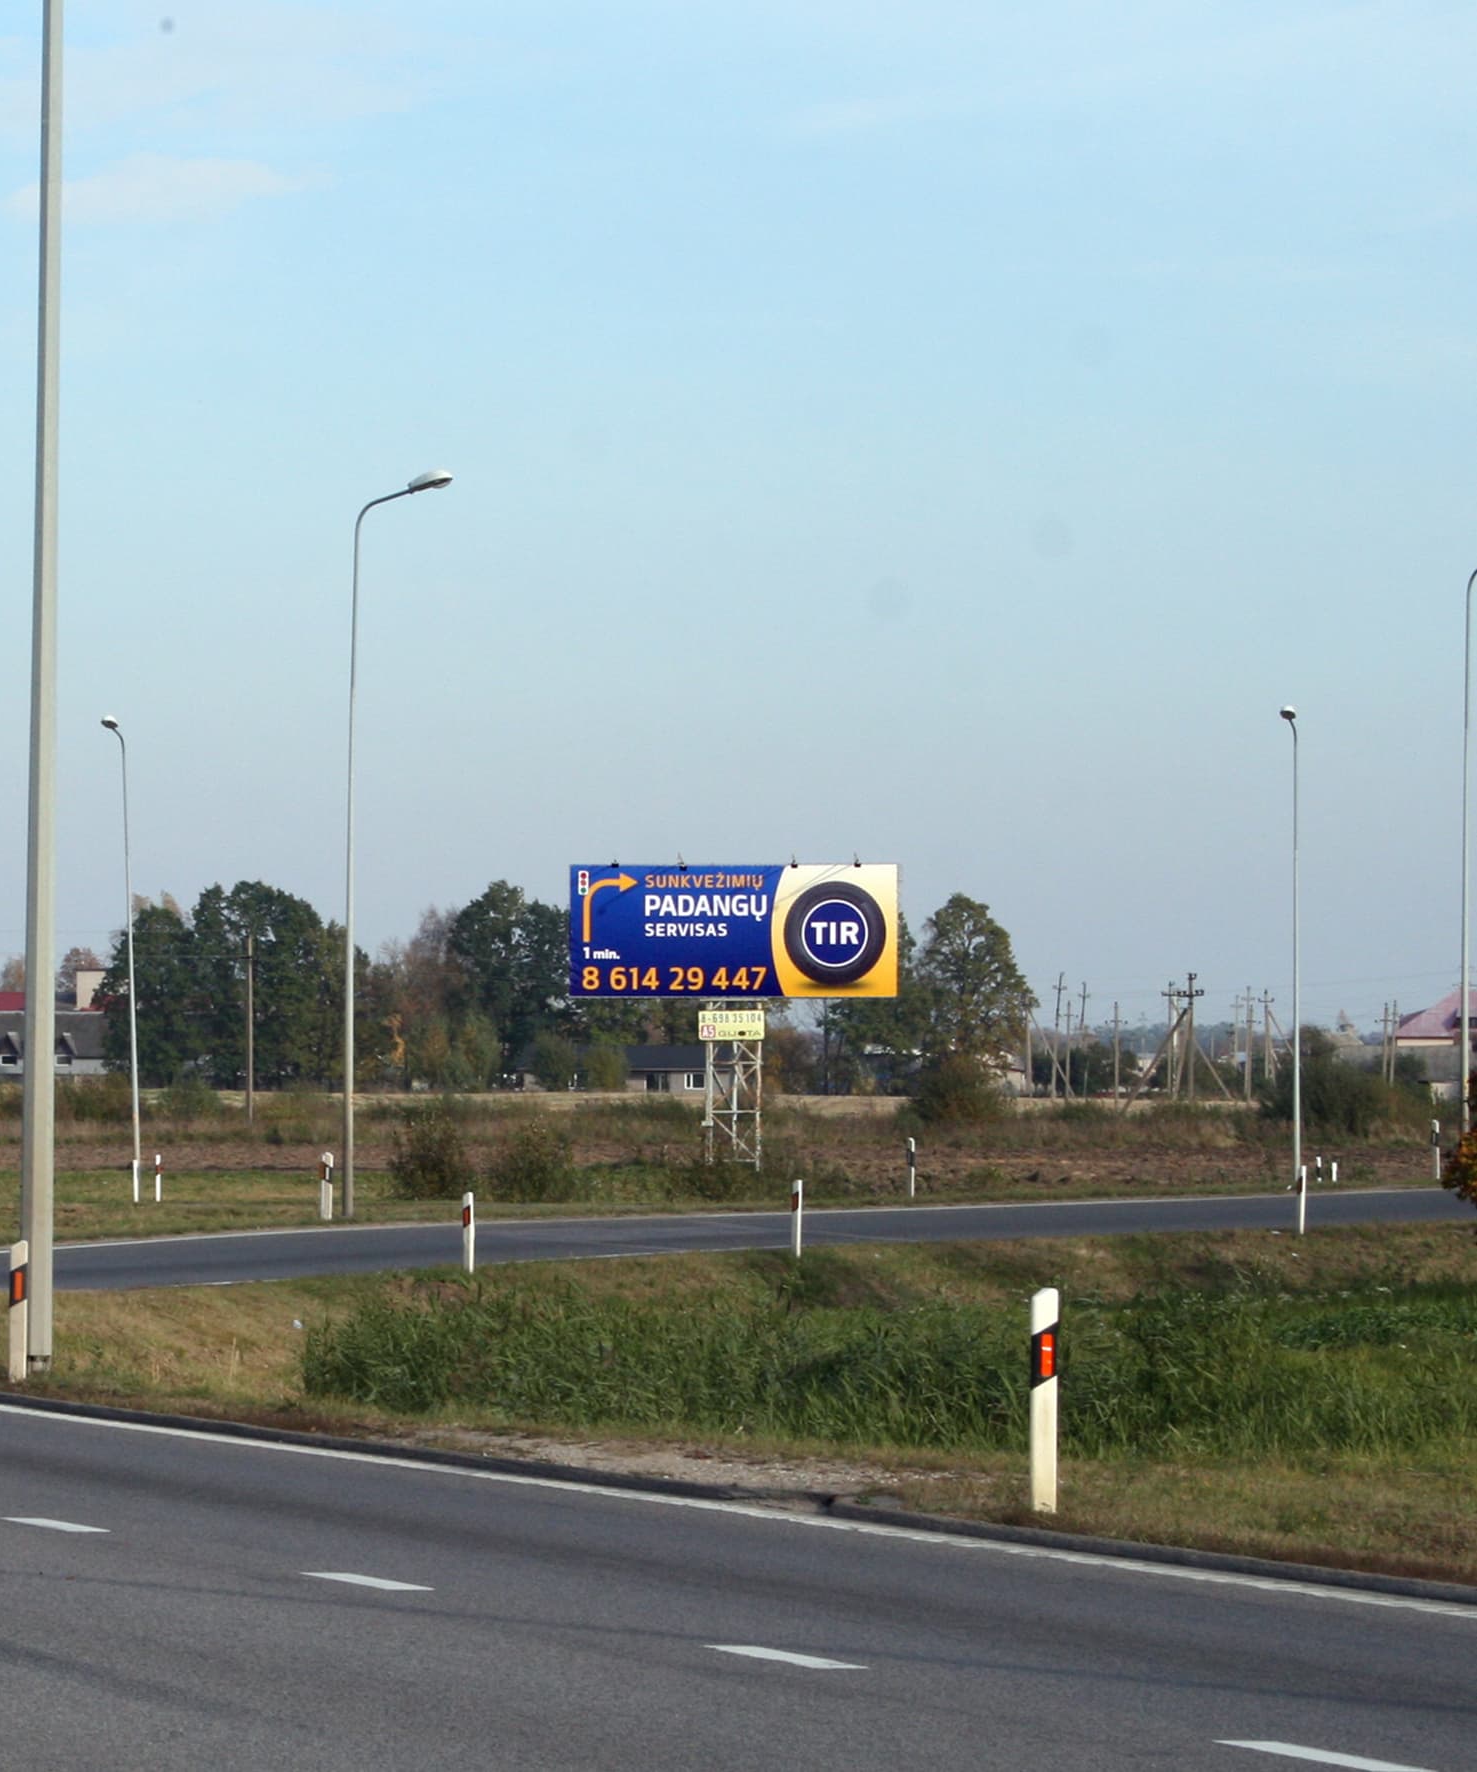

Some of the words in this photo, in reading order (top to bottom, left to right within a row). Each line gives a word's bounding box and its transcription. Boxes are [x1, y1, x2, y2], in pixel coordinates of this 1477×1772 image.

[645, 872, 764, 890] SUNKVEŽIMIŲ
[644, 894, 767, 921] PADANGŲ
[644, 923, 728, 937] SERVISAS
[810, 921, 859, 945] TIR
[583, 946, 590, 960] 1
[593, 948, 620, 960] min.
[582, 966, 600, 990] 8
[609, 966, 660, 990] 614
[669, 966, 704, 990] 29
[711, 966, 767, 990] 447
